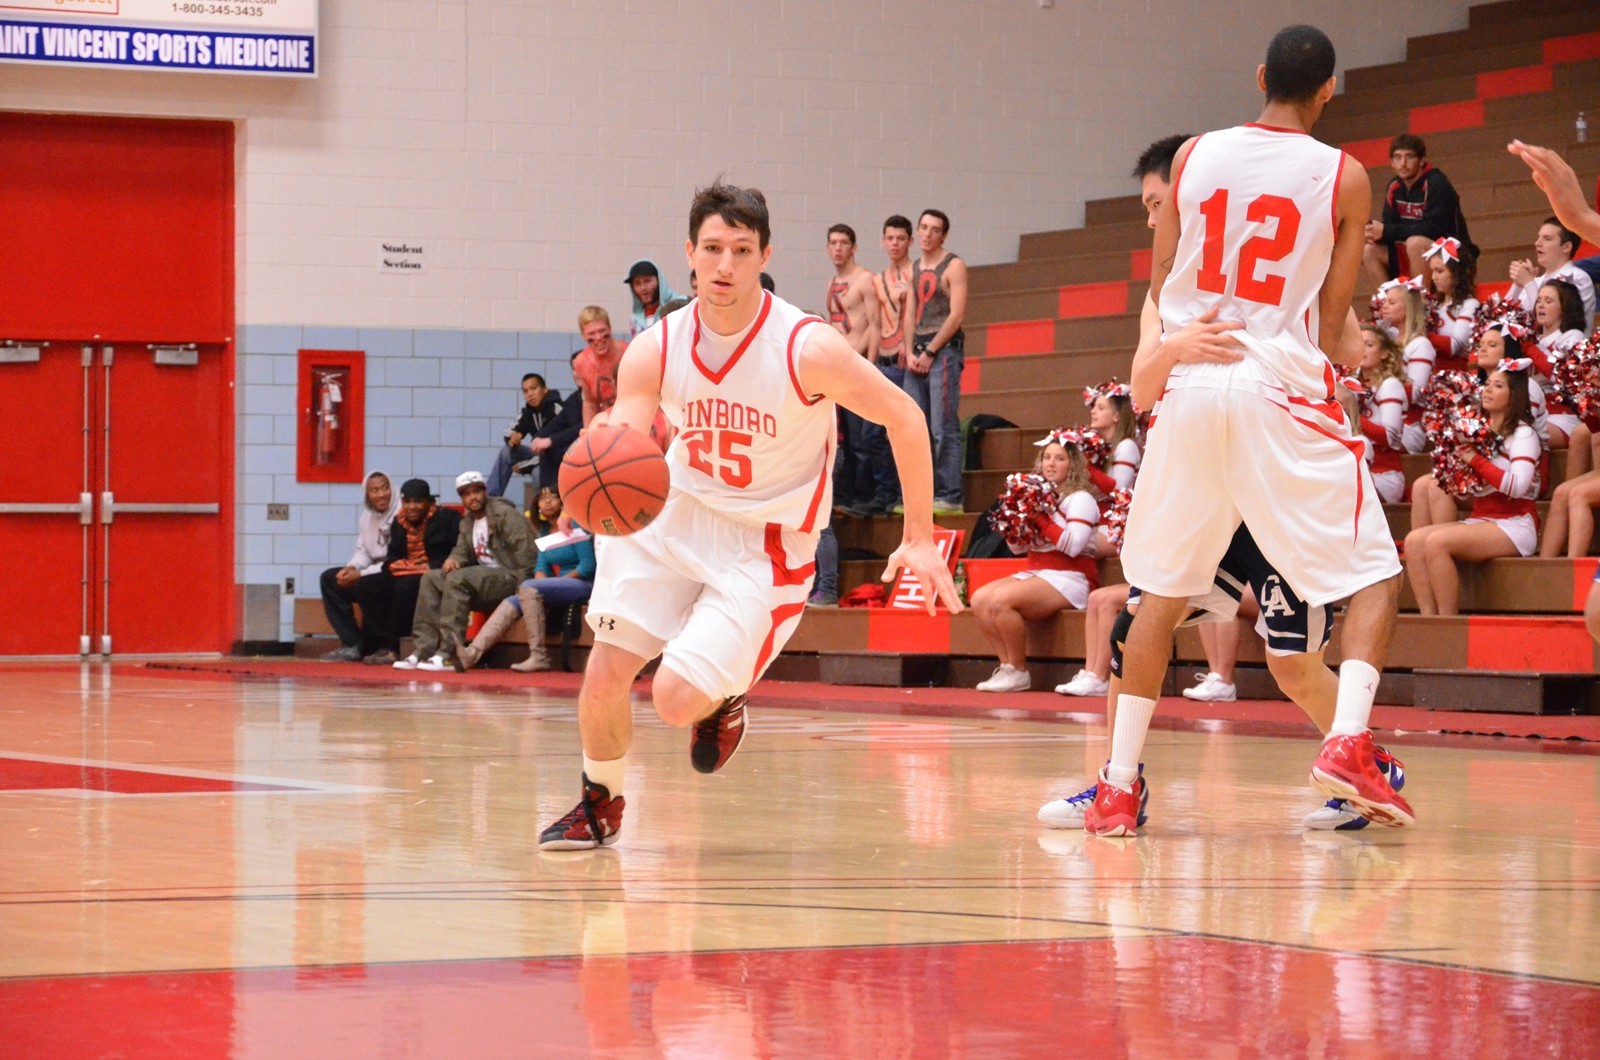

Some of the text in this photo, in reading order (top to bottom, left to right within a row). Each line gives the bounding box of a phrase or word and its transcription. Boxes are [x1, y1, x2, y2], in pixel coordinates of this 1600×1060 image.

[172, 3, 263, 17] 1-800-345-3435
[42, 27, 130, 60] VINCENT
[132, 32, 212, 65] SPORTS
[215, 36, 310, 69] MEDICINE
[382, 243, 423, 254] Student
[383, 259, 421, 269] Section
[1196, 188, 1302, 307] 12
[682, 398, 777, 438] INBORO
[680, 429, 753, 489] 25
